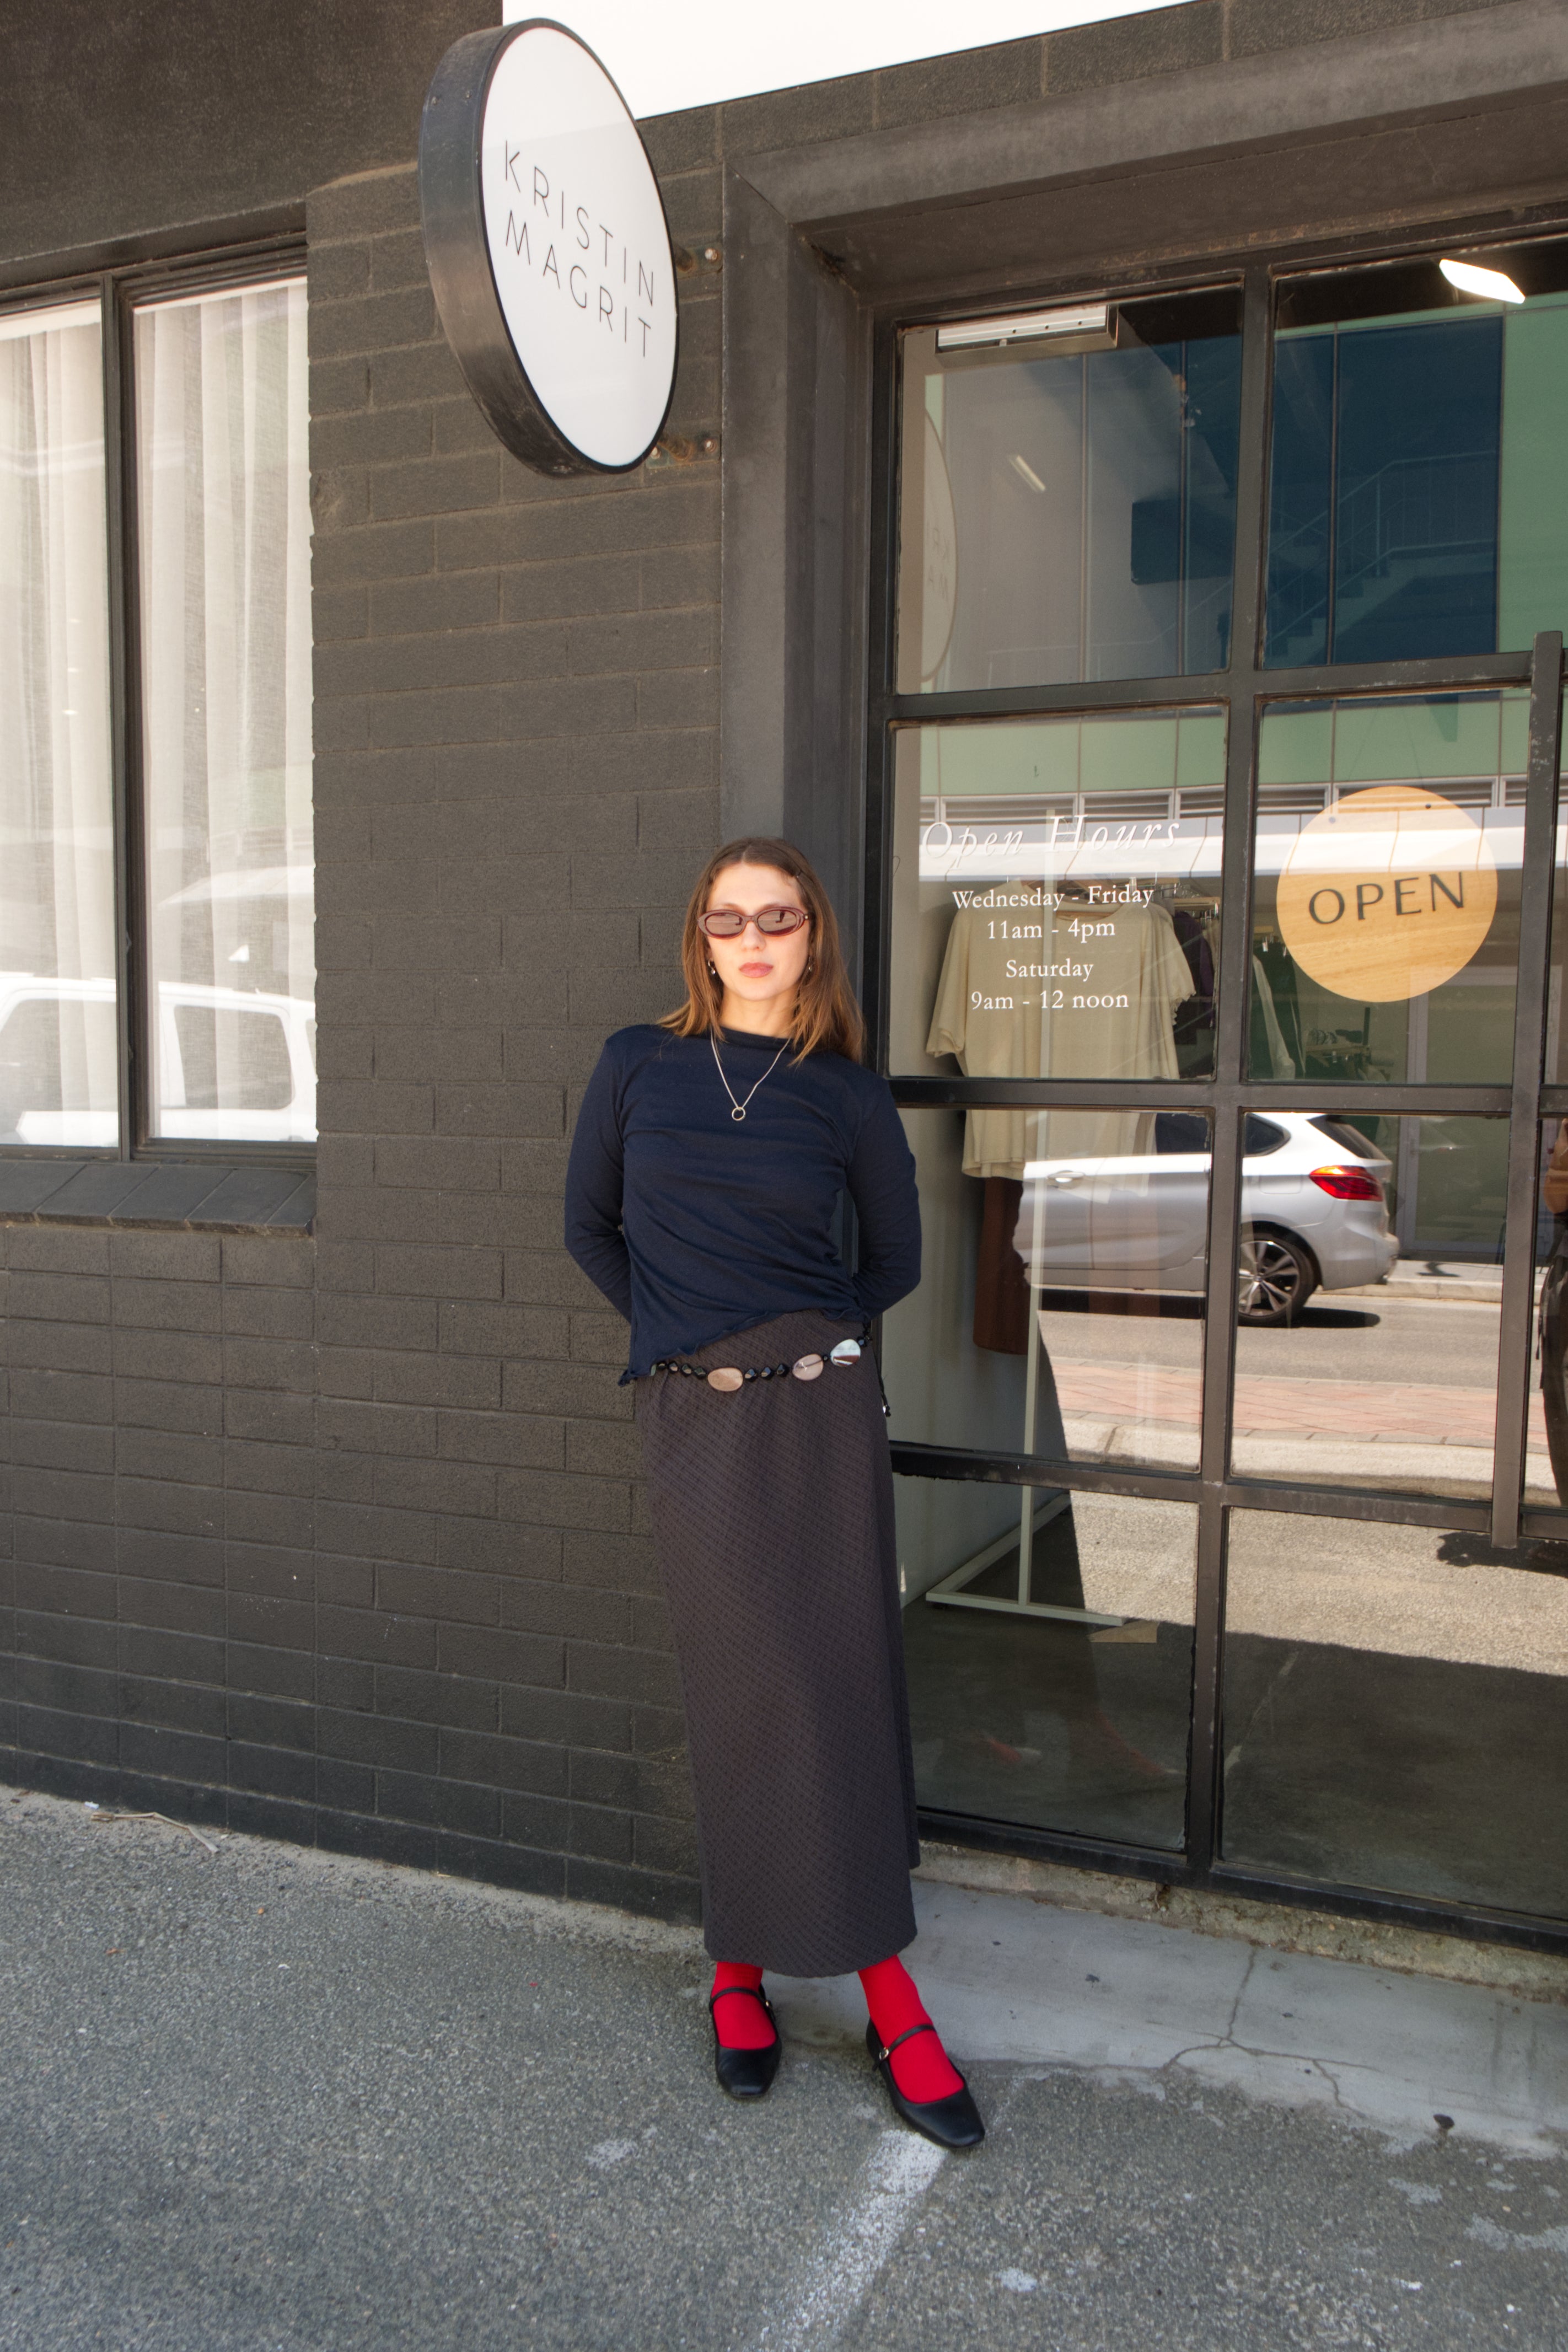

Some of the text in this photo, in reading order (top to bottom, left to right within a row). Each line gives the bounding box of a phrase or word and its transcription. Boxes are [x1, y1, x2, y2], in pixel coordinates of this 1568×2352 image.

[506, 140, 653, 307] KRISTIN
[506, 210, 651, 358] MAGRIT
[922, 814, 1180, 871] Open Hours
[952, 887, 1065, 910] Wednesday
[1088, 884, 1154, 909] Friday
[1308, 871, 1464, 925] OPEN
[987, 920, 1042, 939] 11am
[1068, 918, 1116, 943] 4pm
[1006, 959, 1094, 982] Saturday
[971, 991, 1013, 1010] 9am
[1040, 990, 1064, 1009] 12
[1072, 994, 1129, 1009] noon
